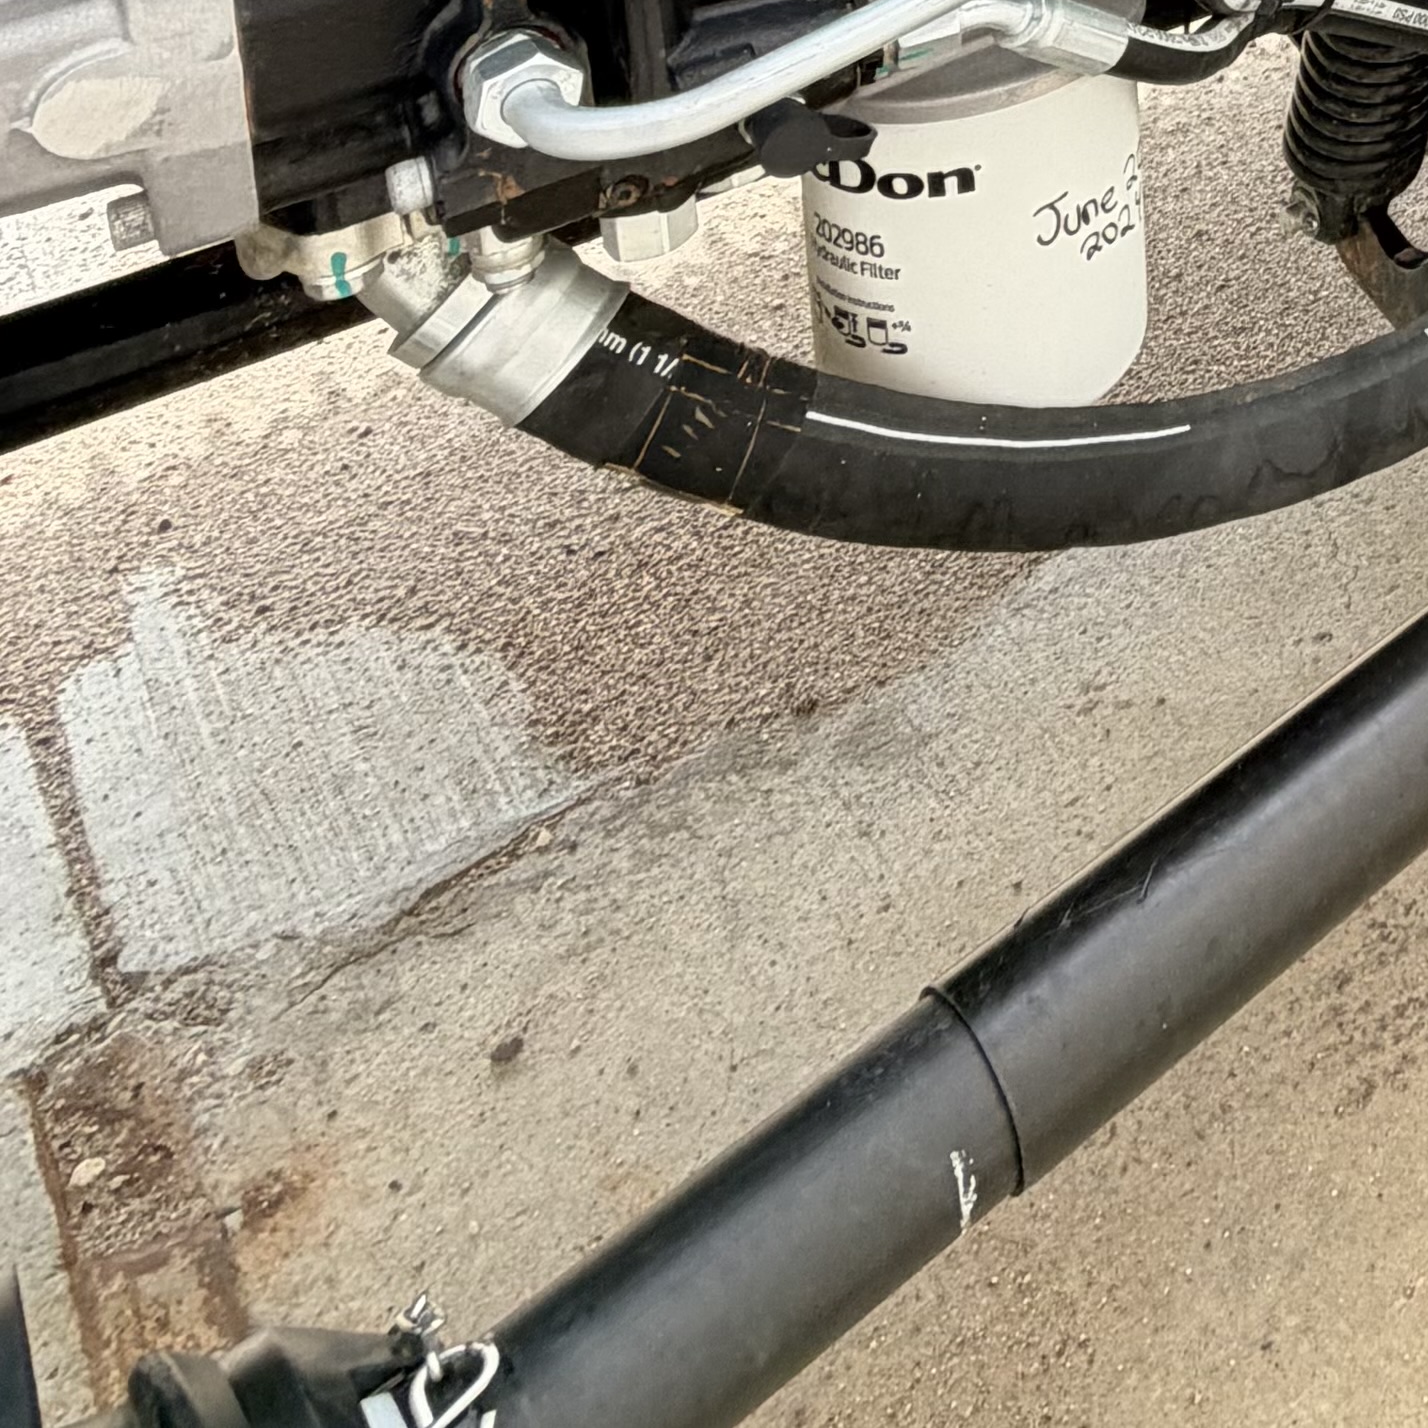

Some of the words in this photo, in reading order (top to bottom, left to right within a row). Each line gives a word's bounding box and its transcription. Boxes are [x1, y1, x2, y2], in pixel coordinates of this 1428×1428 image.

[814, 211, 885, 259] 202986
[1033, 186, 1119, 247] June
[860, 260, 902, 280] Filter
